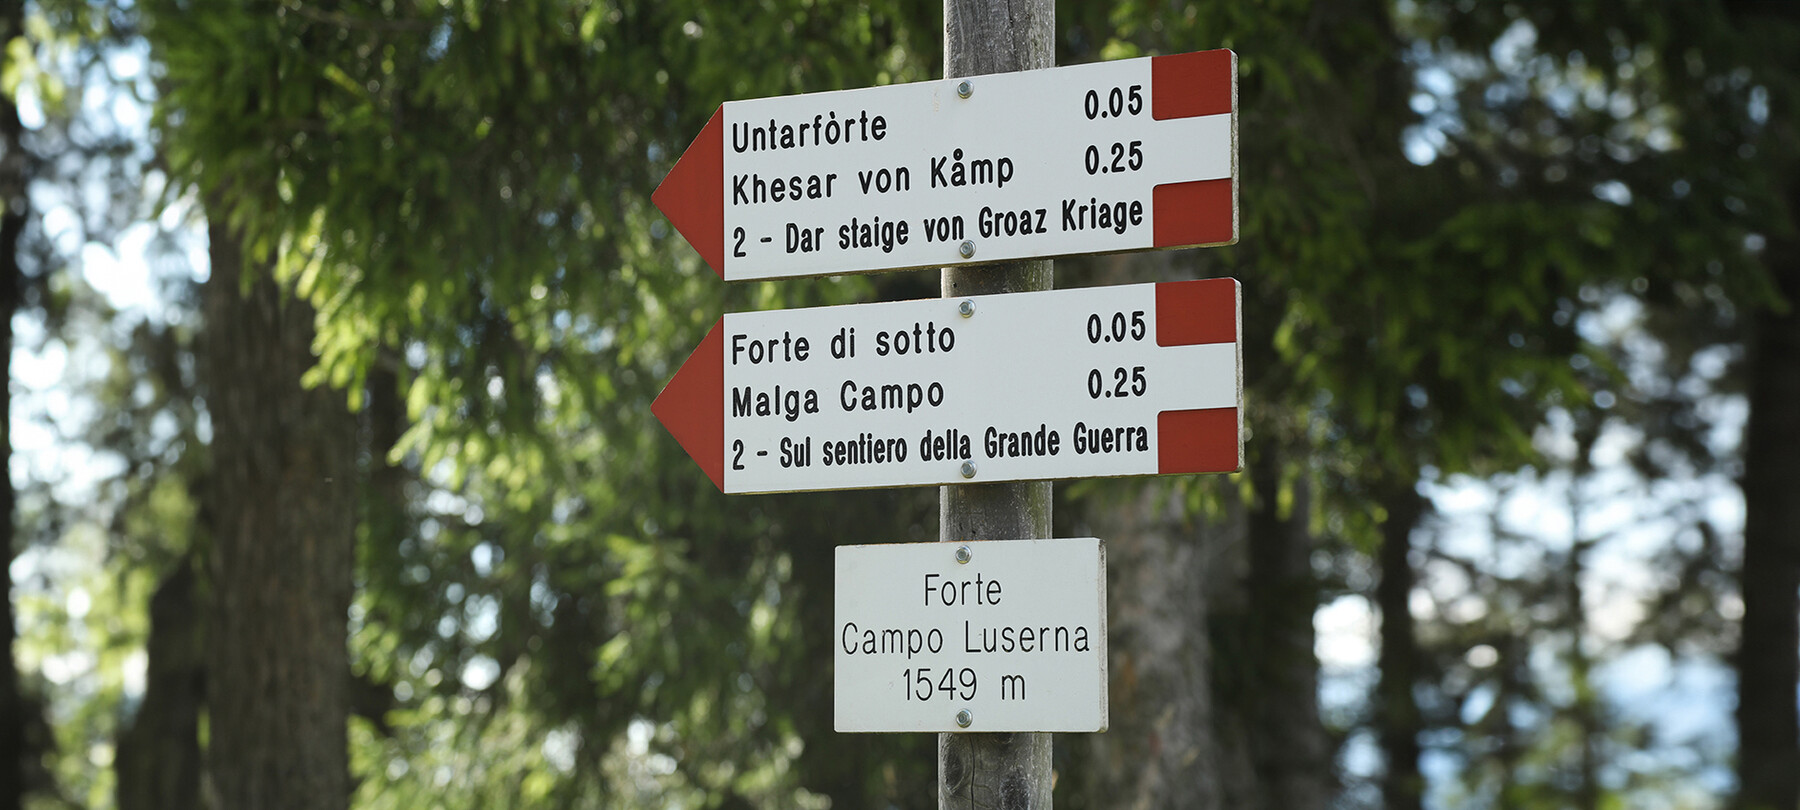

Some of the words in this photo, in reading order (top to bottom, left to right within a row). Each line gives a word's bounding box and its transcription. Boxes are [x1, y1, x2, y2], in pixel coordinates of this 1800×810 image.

[733, 110, 886, 153] Untarfòrte
[1085, 85, 1142, 120] 0.05
[733, 174, 837, 205] Khesar
[858, 167, 909, 194] von
[931, 148, 1013, 188] Kåmp
[1085, 141, 1143, 175] 0.25
[734, 227, 746, 257] 2
[786, 223, 824, 253] Dar
[839, 216, 908, 253] staige
[923, 216, 964, 242] von
[979, 206, 1047, 238] Groaz
[1062, 197, 1142, 234] Kriage
[732, 331, 809, 365] Forte
[831, 327, 855, 359] di
[876, 322, 955, 356] sotto
[1087, 311, 1145, 343] 0.05
[733, 385, 819, 422] Malga
[841, 380, 943, 413] Campo
[1088, 366, 1146, 399] 0.25
[733, 439, 744, 470] 2
[780, 436, 810, 468] Sul
[823, 433, 907, 466] sentiero
[920, 429, 971, 461] della
[985, 424, 1060, 458] Grande
[1074, 422, 1148, 454] Guerra
[925, 573, 1001, 606] Forte
[842, 622, 943, 659] Campo
[966, 621, 1089, 653] Luserna
[903, 668, 976, 701] 1549
[1002, 675, 1025, 700] m
